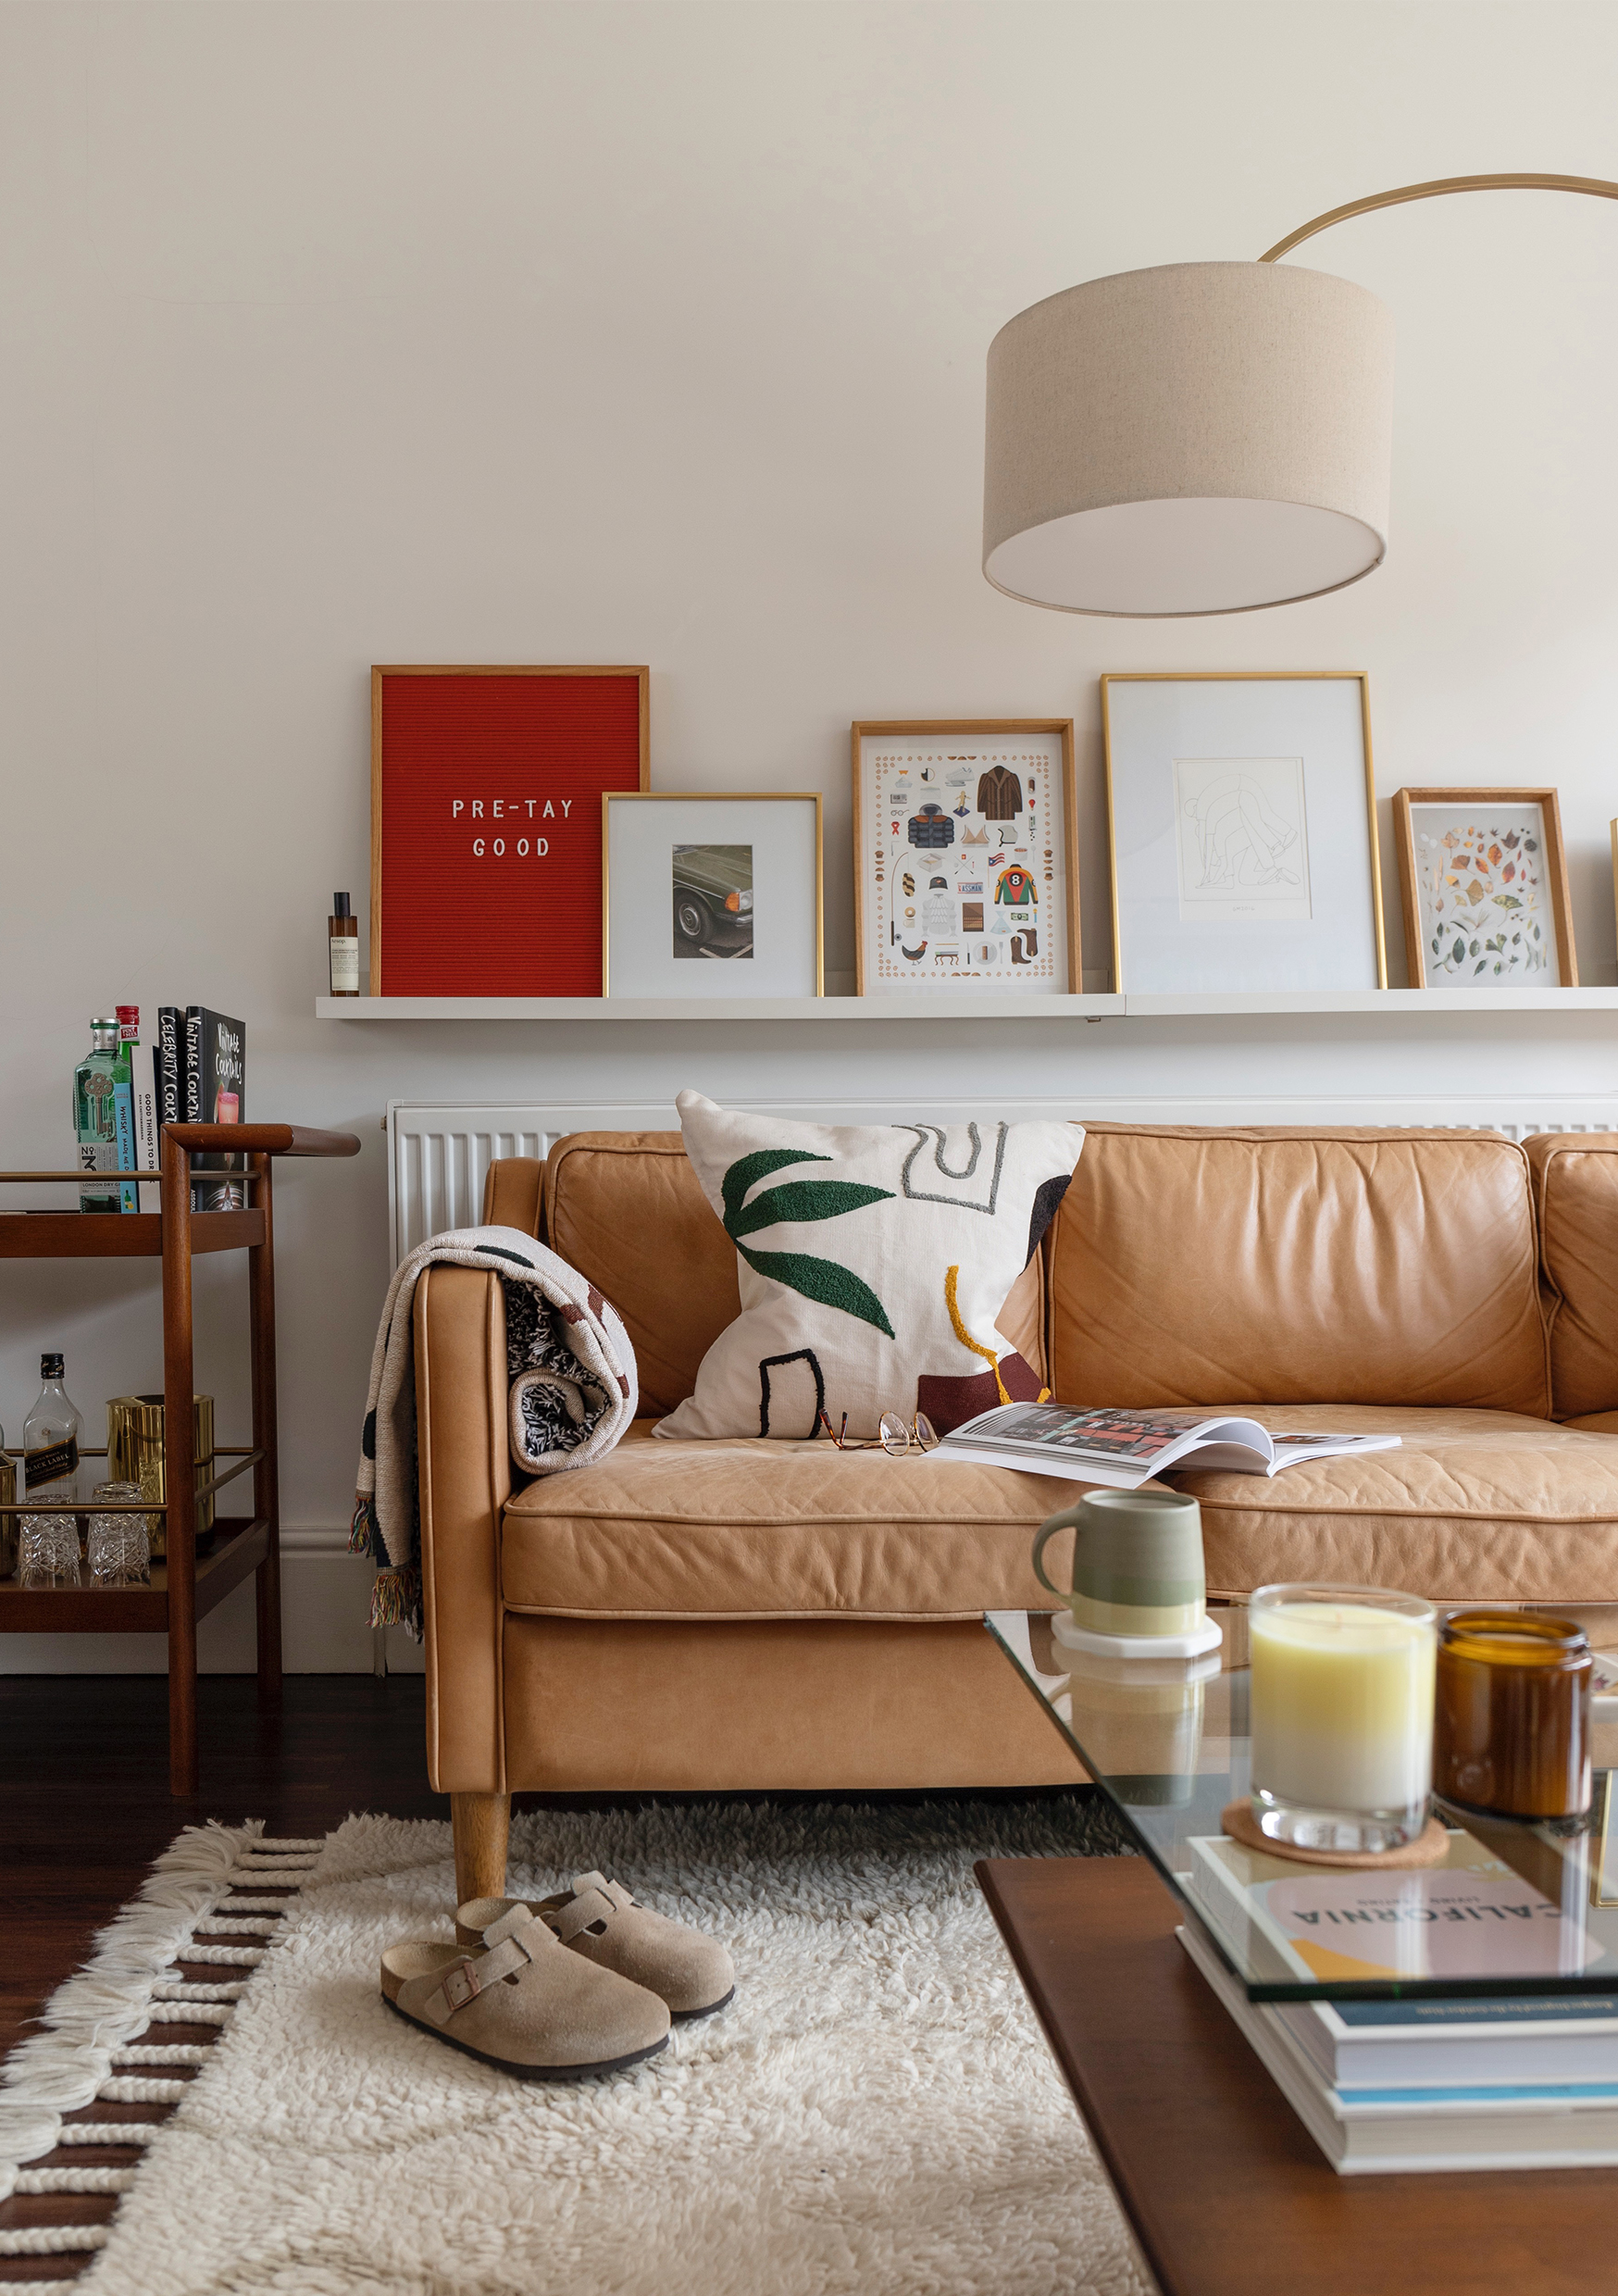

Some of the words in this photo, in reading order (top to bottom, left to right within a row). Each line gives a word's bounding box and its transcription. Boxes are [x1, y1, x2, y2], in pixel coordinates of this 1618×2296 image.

[453, 800, 572, 818] PRE-TAY
[472, 838, 549, 857] GOOD
[1012, 874, 1021, 885] 8
[164, 1083, 178, 1123] COCKT
[119, 1105, 129, 1135] WHISKY
[123, 1156, 130, 1165] ME
[147, 1148, 155, 1158] TO
[25, 1462, 46, 1473] BLACK
[47, 1454, 70, 1465] LABEL
[1292, 1903, 1562, 1926] CALIFORNIA
